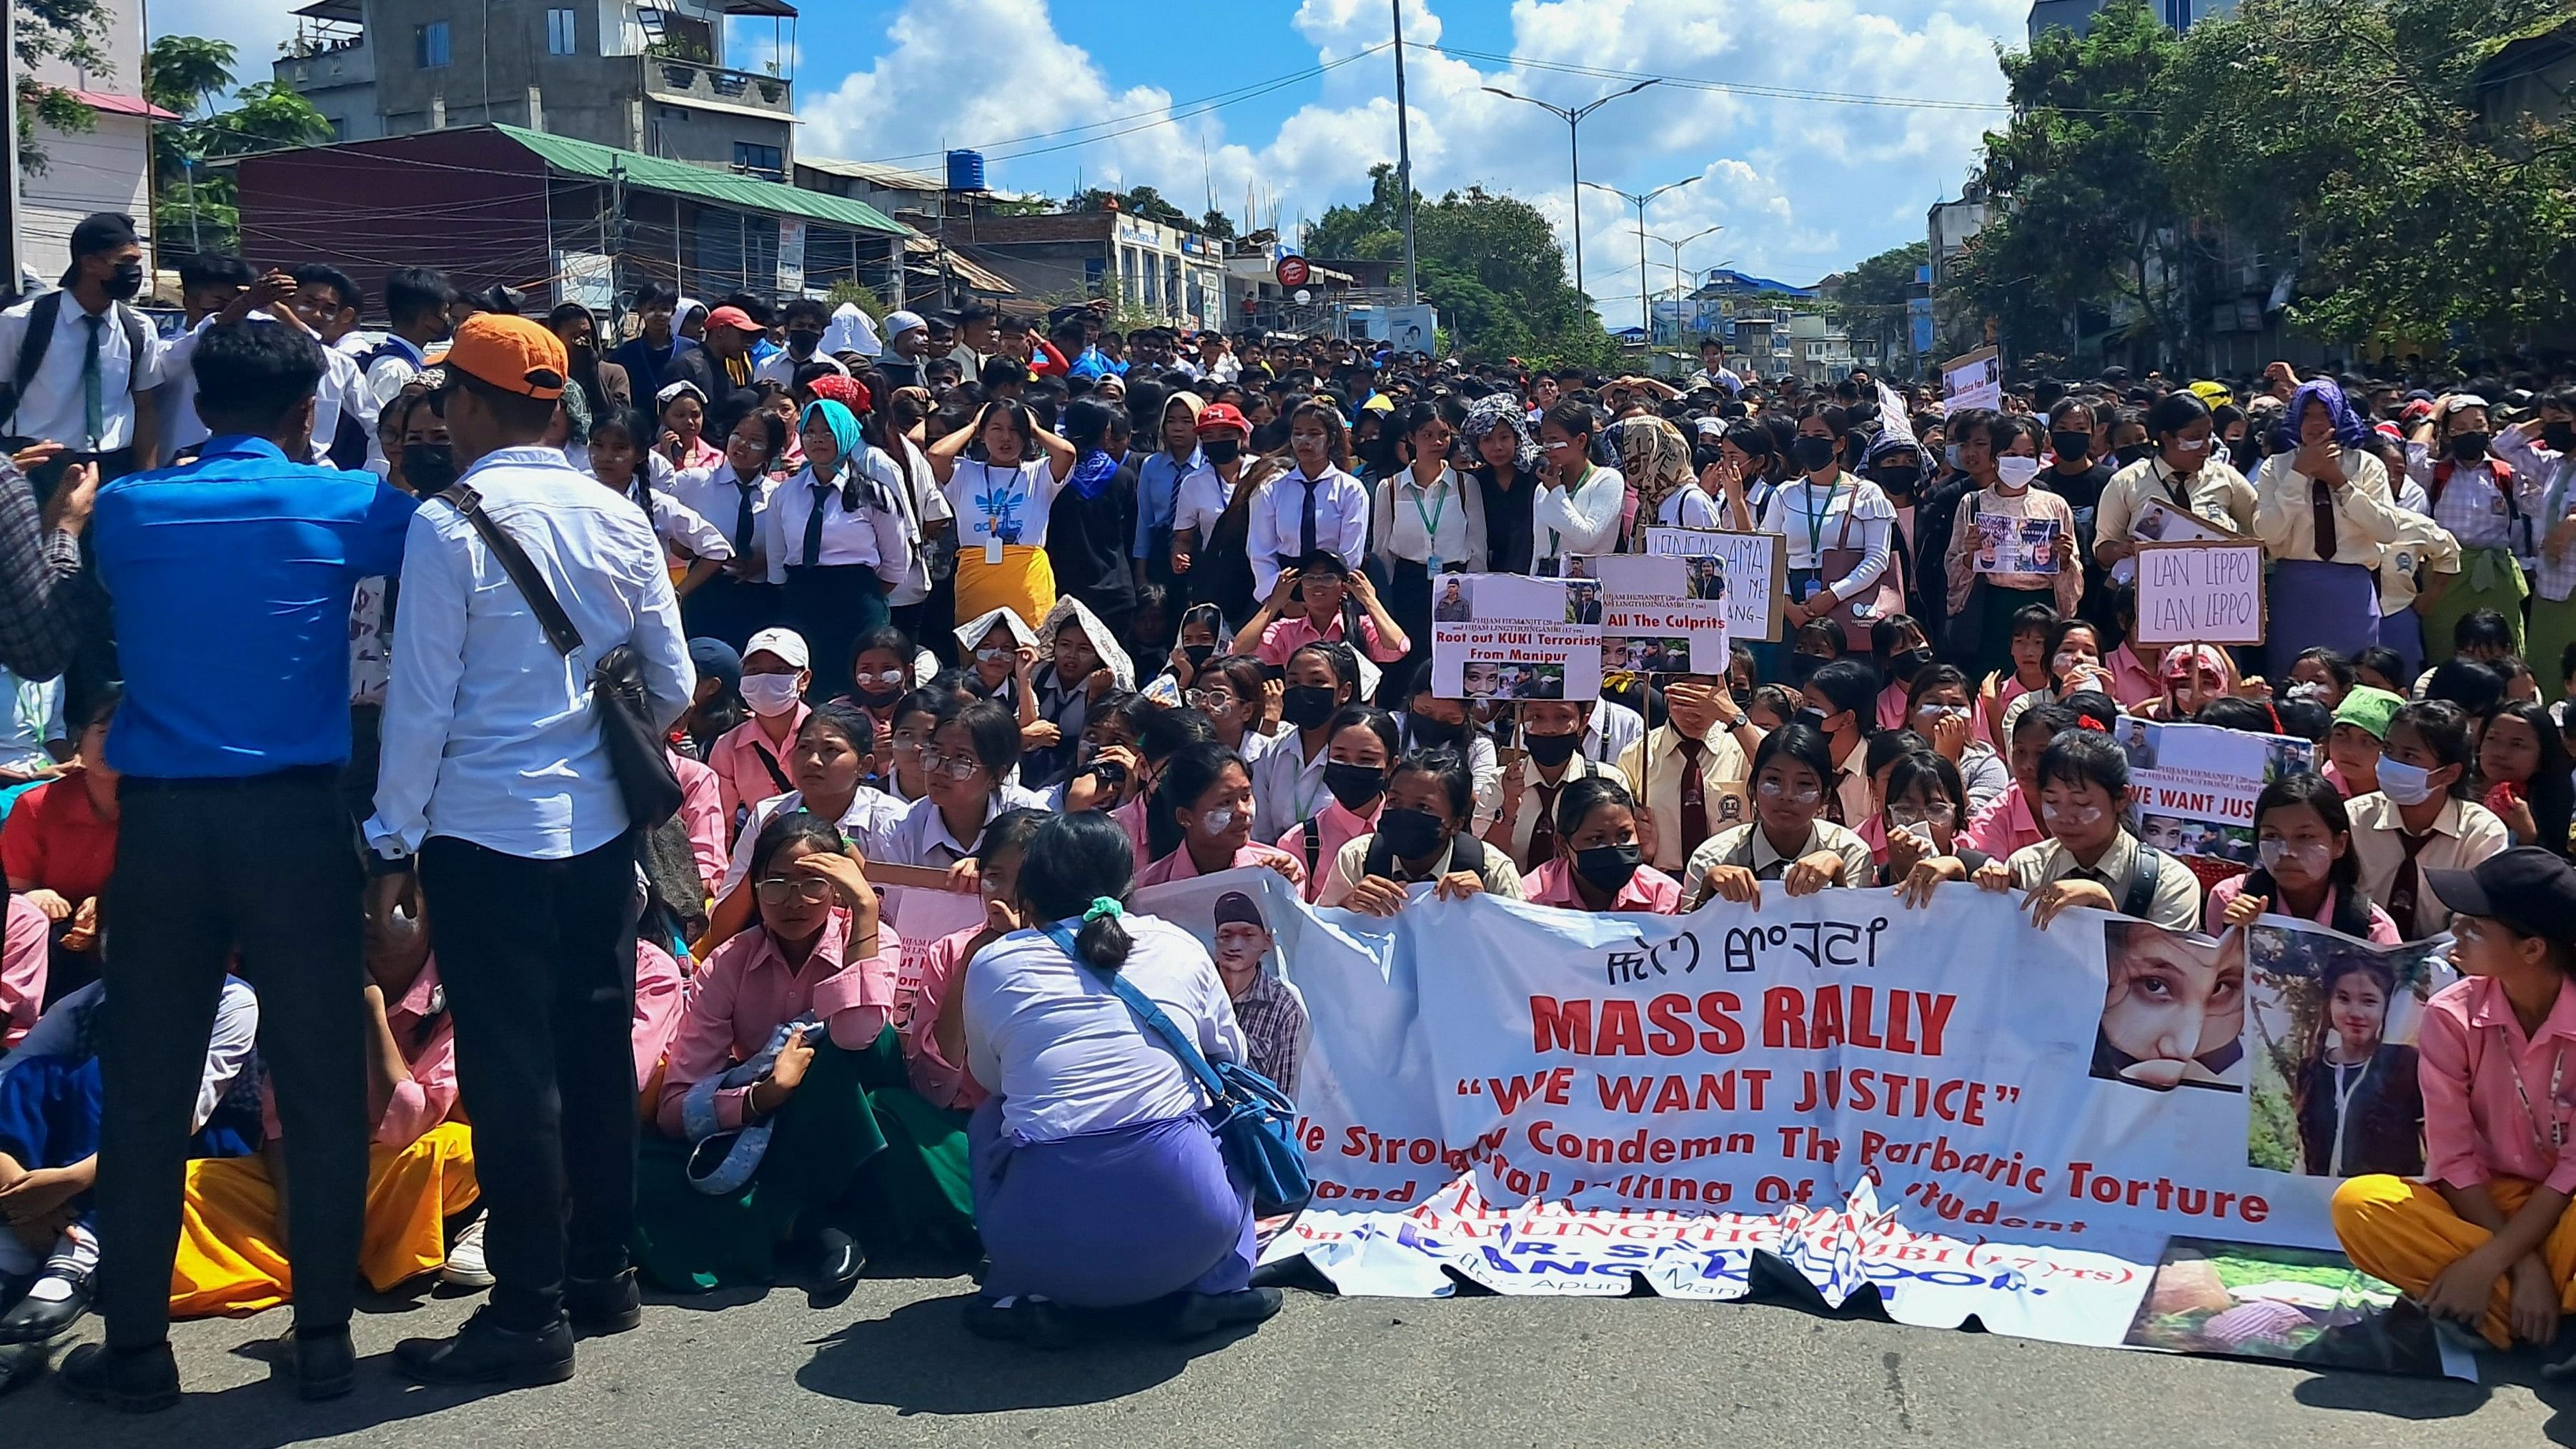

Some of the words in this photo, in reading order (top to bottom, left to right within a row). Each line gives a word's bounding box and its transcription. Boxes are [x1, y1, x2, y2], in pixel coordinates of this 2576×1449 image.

[2154, 553, 2190, 587] LAN
[2206, 552, 2250, 585] LEPPO
[1607, 614, 1628, 627] All
[1633, 614, 1660, 627] The
[1665, 615, 1725, 631] Culprits
[2154, 595, 2194, 632] LAN
[2205, 592, 2251, 628] LEPPO
[1437, 631, 1467, 643] Root
[1472, 634, 1493, 644] out
[1498, 633, 1532, 644] KUKI
[1537, 634, 1602, 646] Terrorists
[1470, 649, 1505, 660] From
[1510, 650, 1568, 663] Manipur
[2159, 788, 2216, 813] WANT
[900, 957, 914, 968] ut
[1530, 991, 1745, 1057] MASS
[1763, 984, 1957, 1057] RALLY
[1597, 1069, 1772, 1114] WANT
[1527, 1120, 1755, 1164] Condemn
[2068, 1162, 2270, 1223] Torture
[1316, 1181, 1416, 1202] and
[1755, 1175, 1814, 1204] Of
